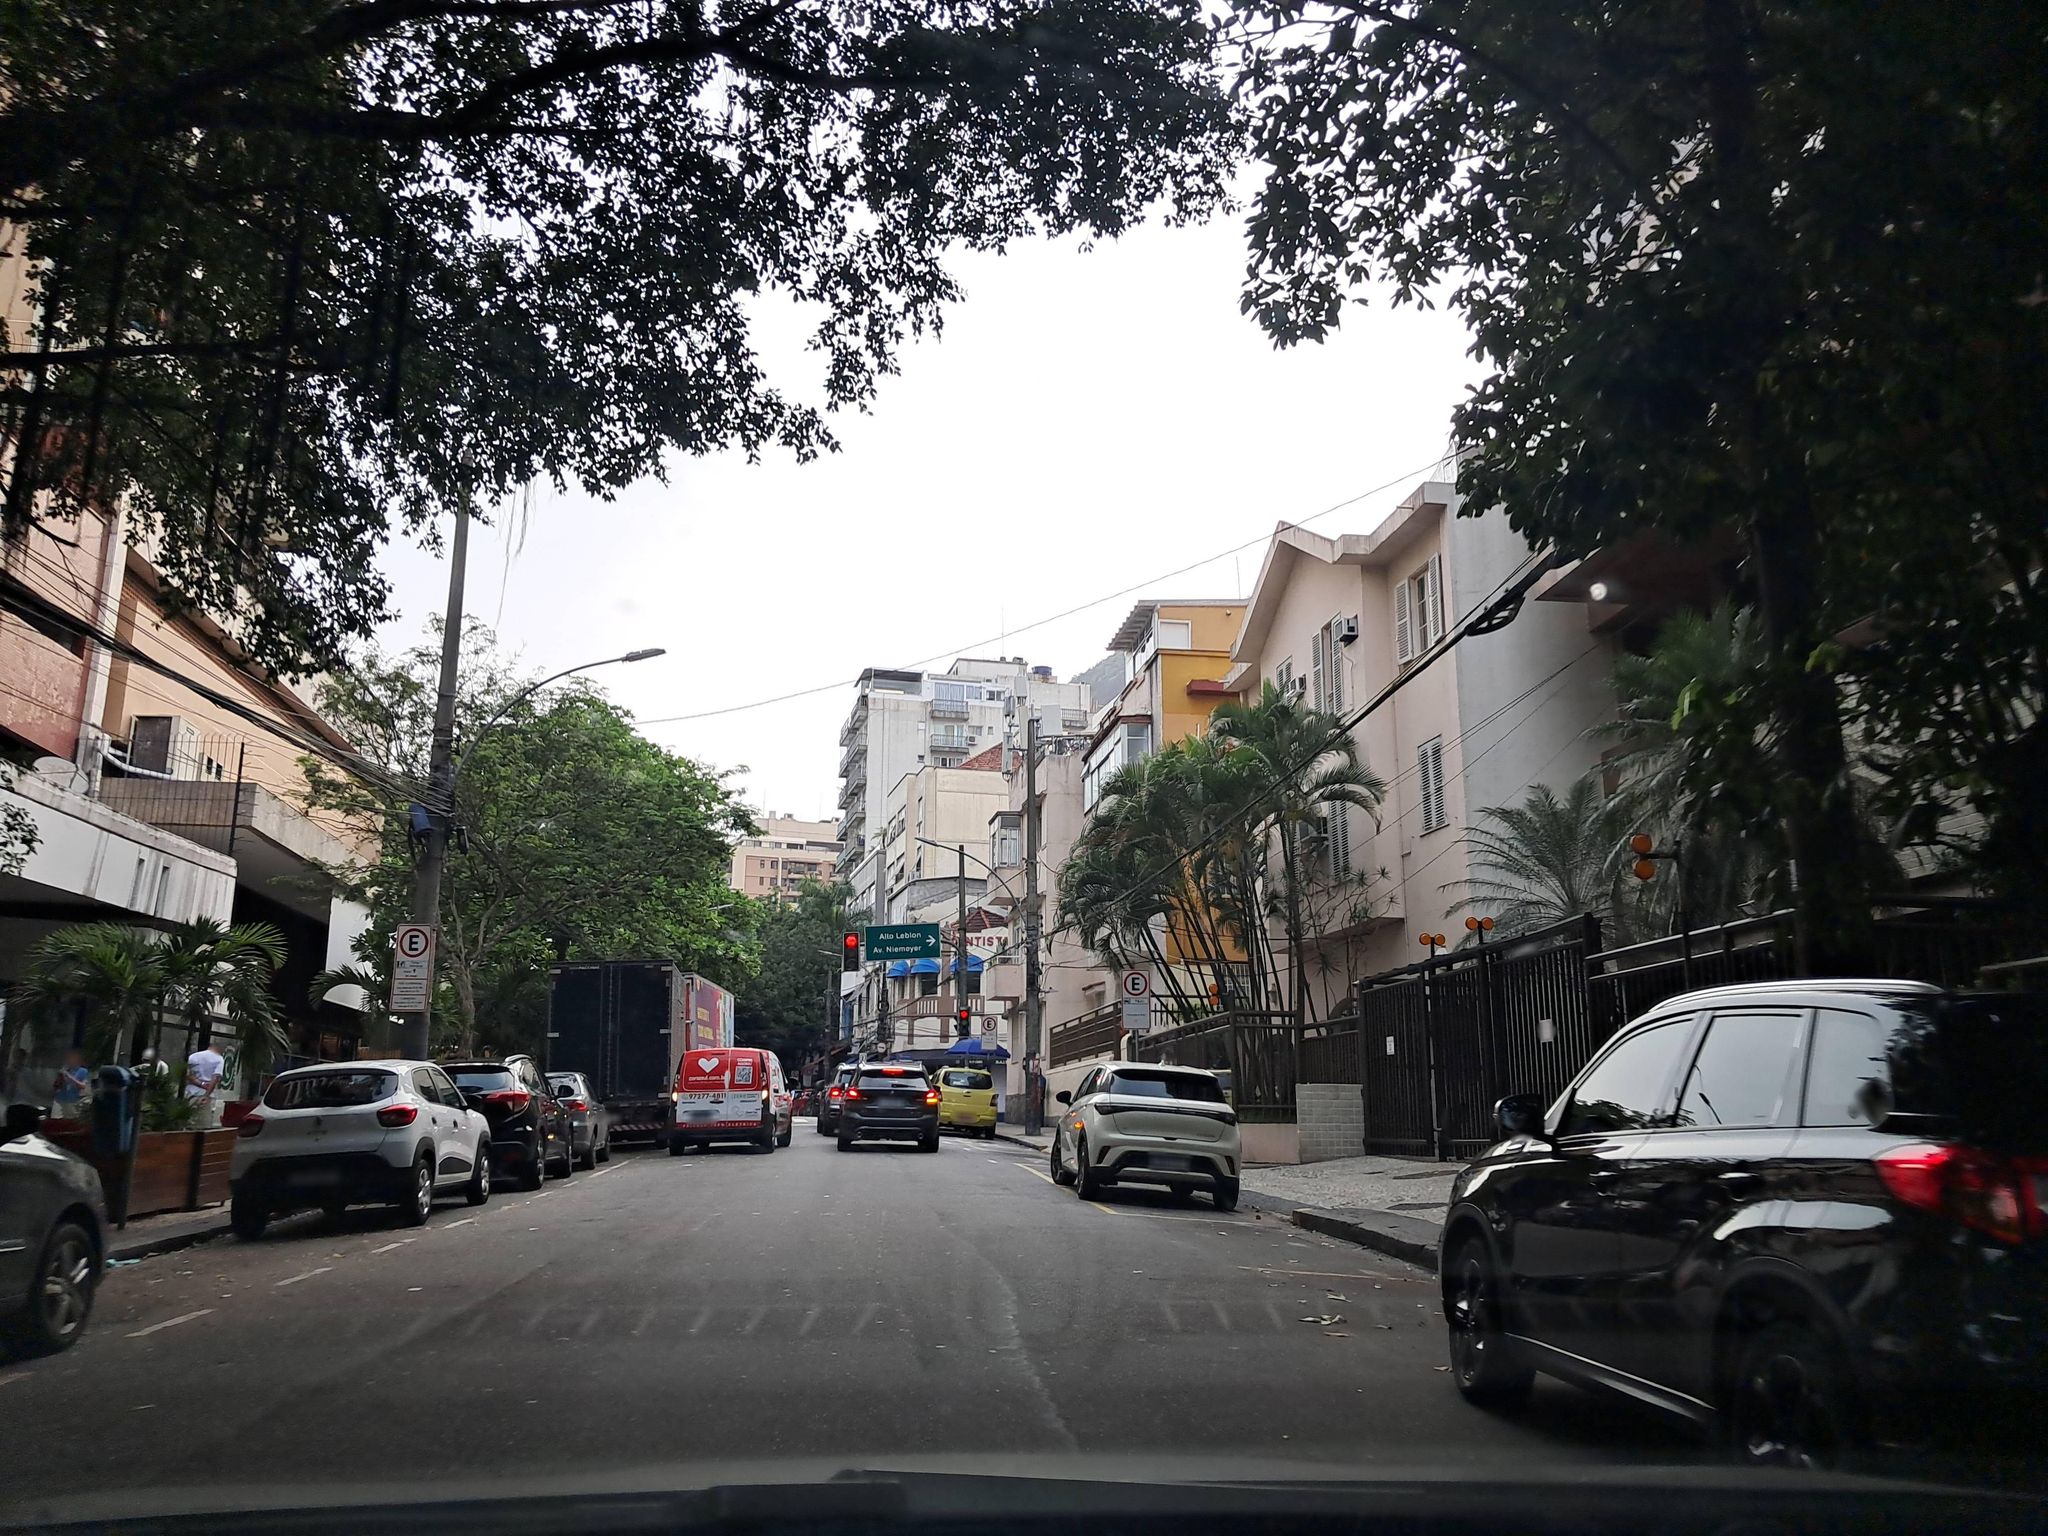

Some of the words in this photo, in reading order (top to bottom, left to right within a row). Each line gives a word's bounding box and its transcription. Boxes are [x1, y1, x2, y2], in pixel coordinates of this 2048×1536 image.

[409, 935, 420, 952] E
[886, 945, 922, 954] Niemeyer
[1131, 977, 1140, 991] E
[986, 1020, 993, 1029] E
